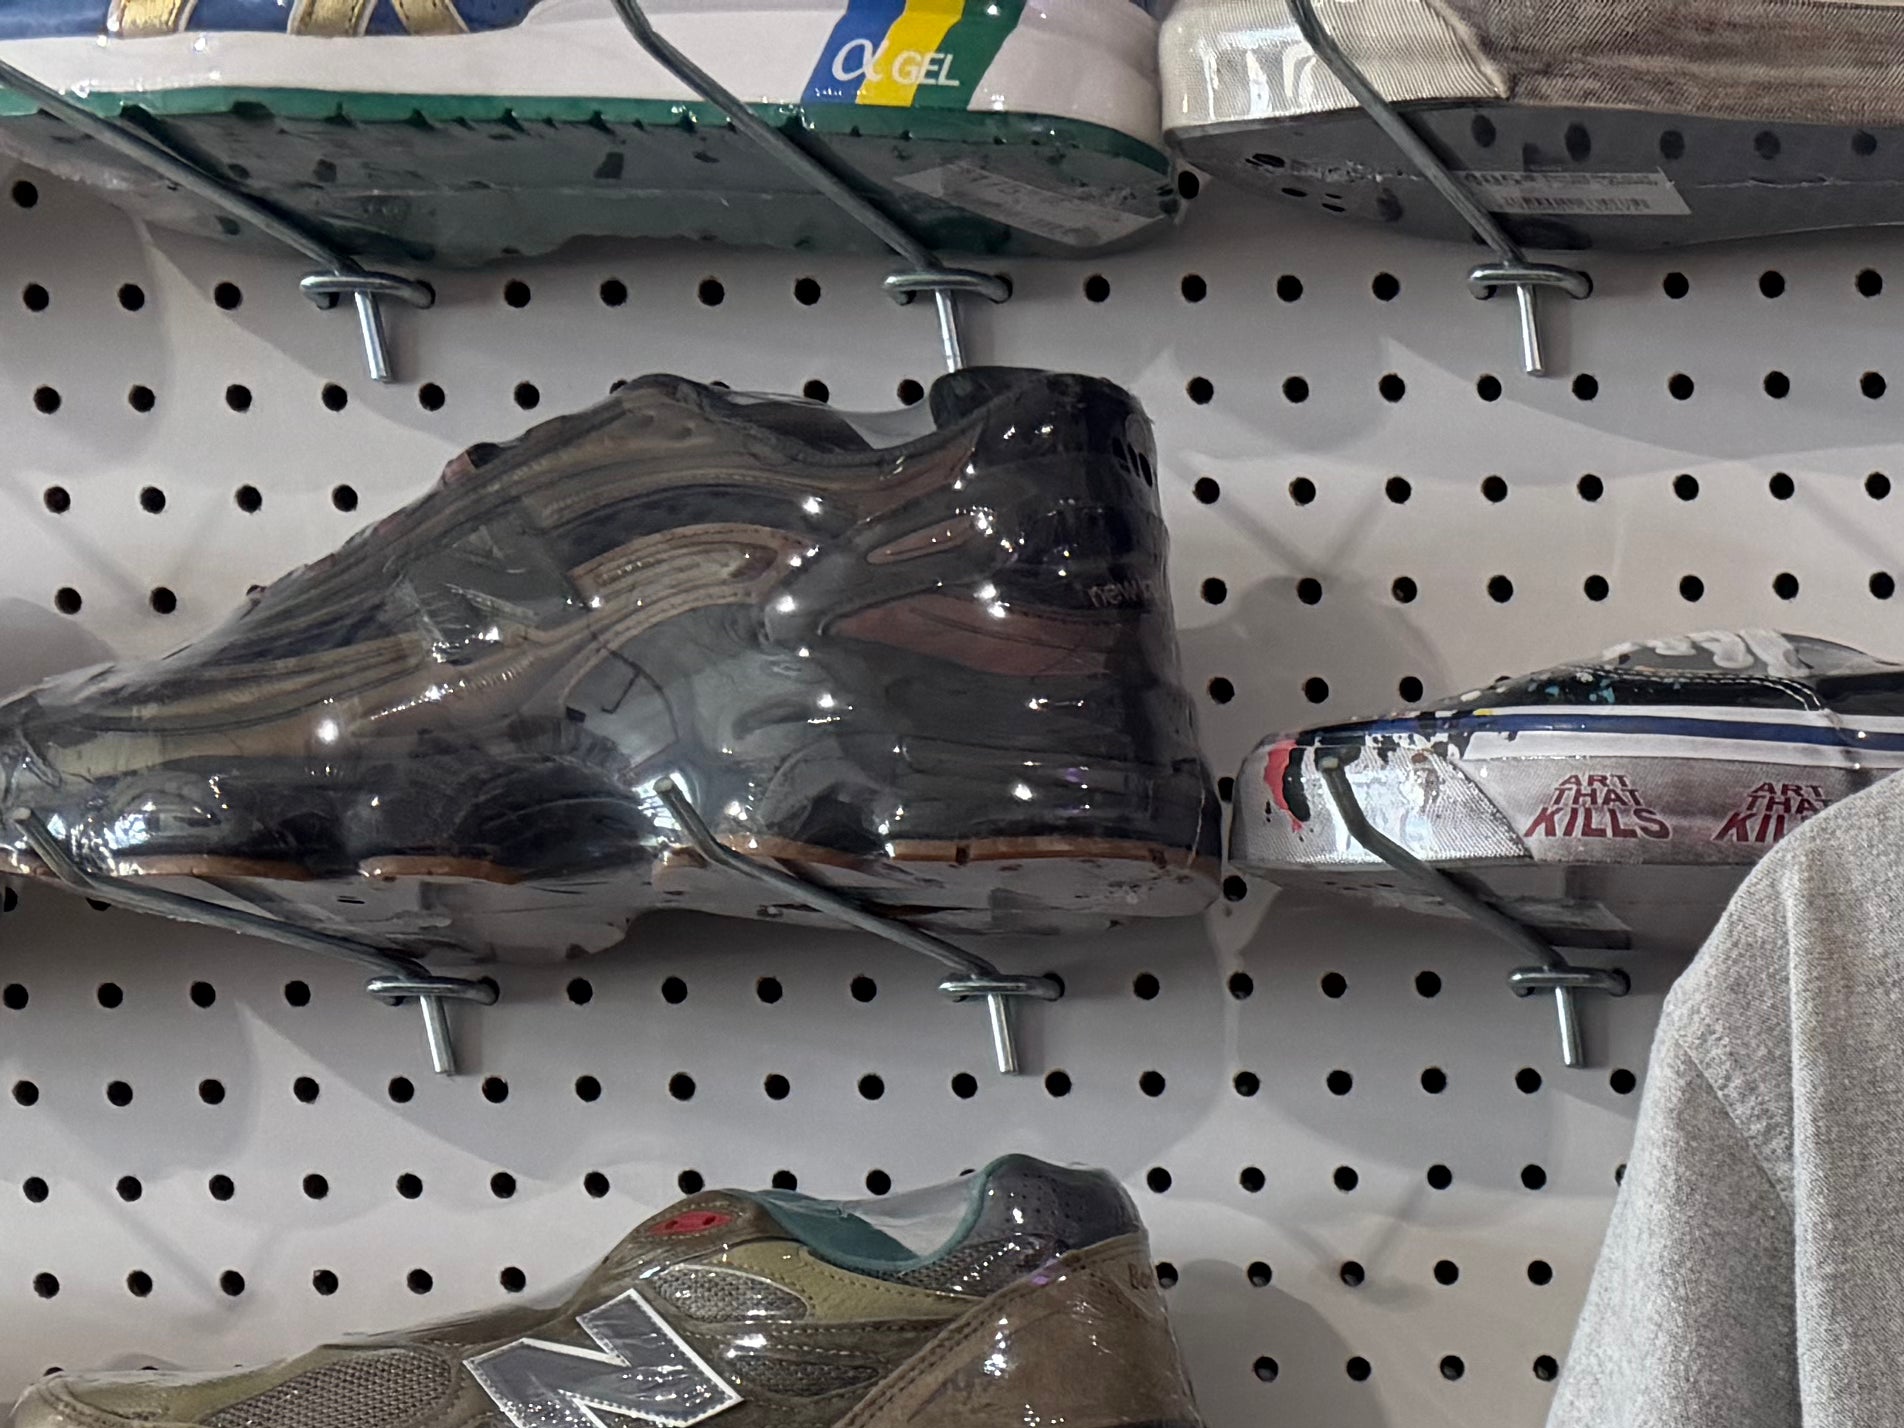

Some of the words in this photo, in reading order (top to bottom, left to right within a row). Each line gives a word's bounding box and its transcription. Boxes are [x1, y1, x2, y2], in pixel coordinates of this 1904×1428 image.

[892, 51, 960, 86] GEL
[1558, 774, 1630, 788] ART
[1751, 782, 1823, 797] ART
[1553, 787, 1643, 806] THAT
[1523, 806, 1671, 839] KILLS
